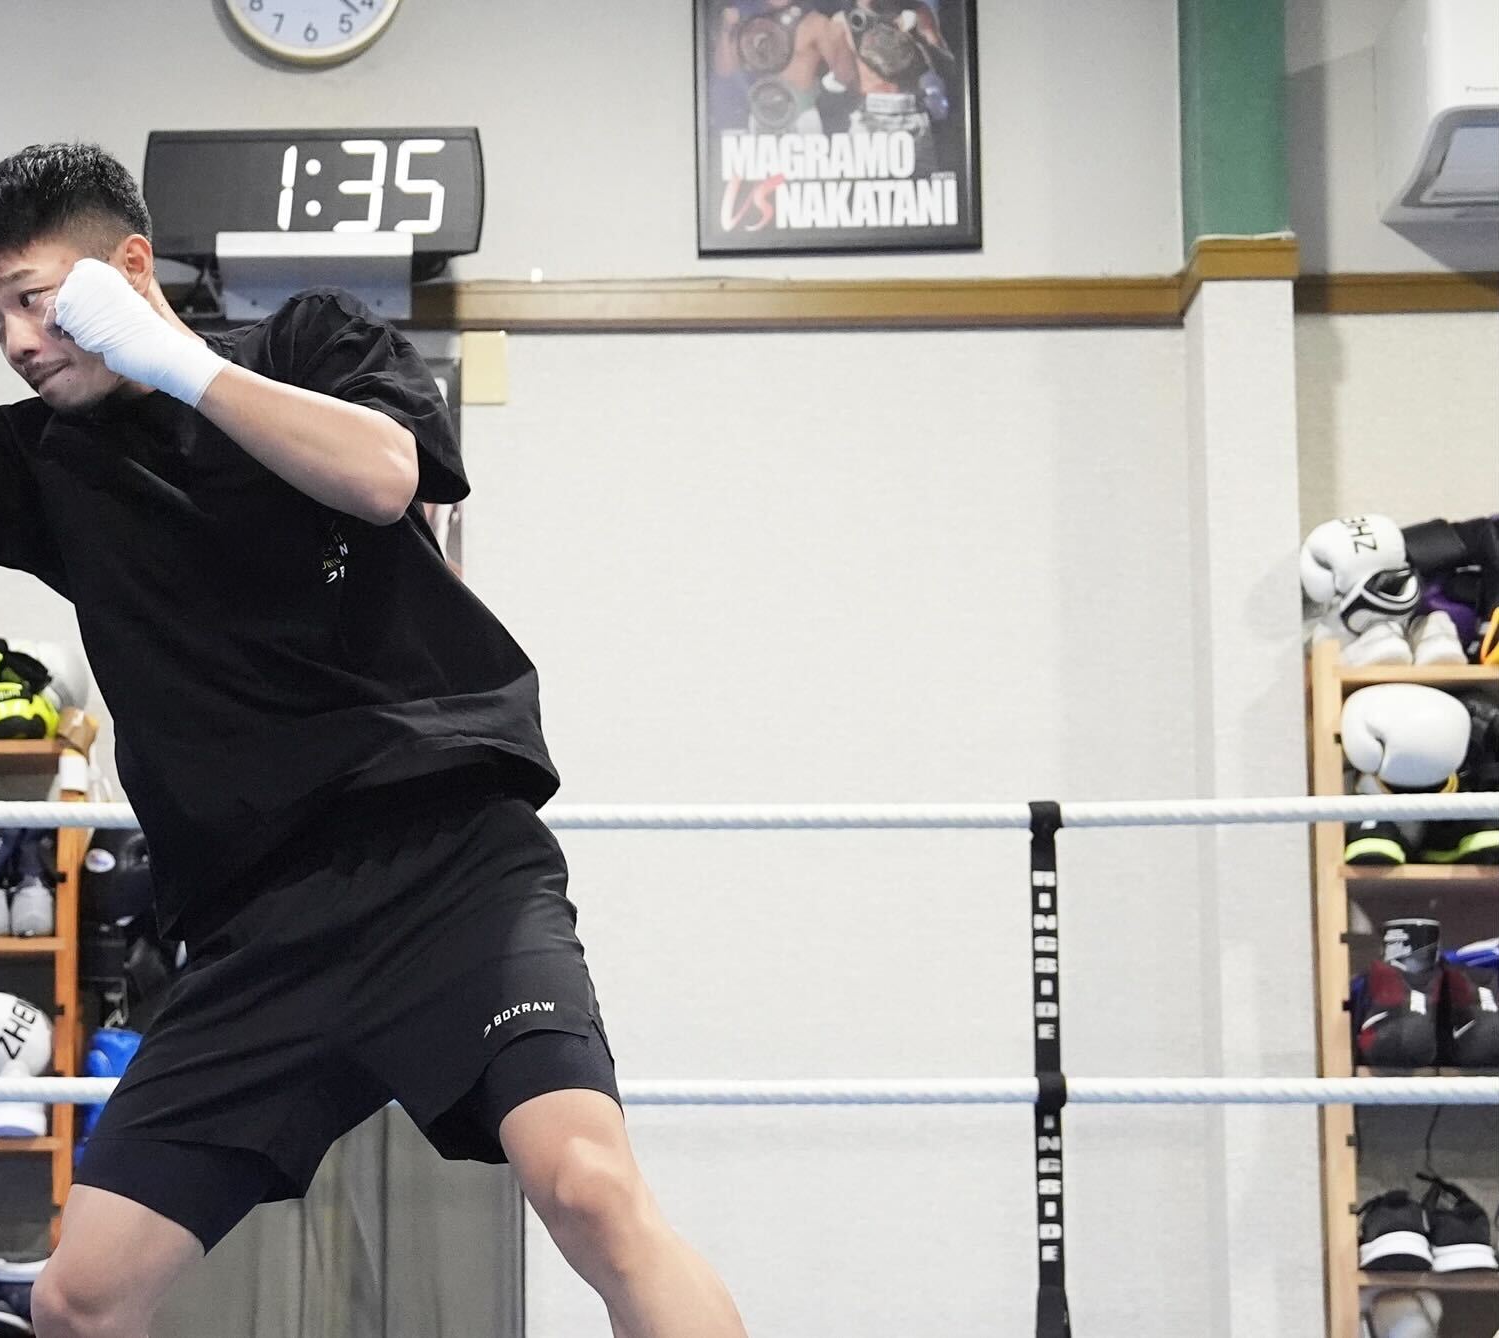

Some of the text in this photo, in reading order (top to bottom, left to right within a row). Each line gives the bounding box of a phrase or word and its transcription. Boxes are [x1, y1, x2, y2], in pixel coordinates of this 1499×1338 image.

[273, 13, 285, 33] 7
[304, 23, 318, 42] 6
[339, 14, 353, 33] 5
[721, 131, 916, 181] MAGRAMO
[277, 139, 445, 233] 1:35
[721, 175, 958, 232] VS NAKATANI
[493, 1001, 555, 1027] BOXRAW
[1037, 1114, 1063, 1262] INGSIDE
